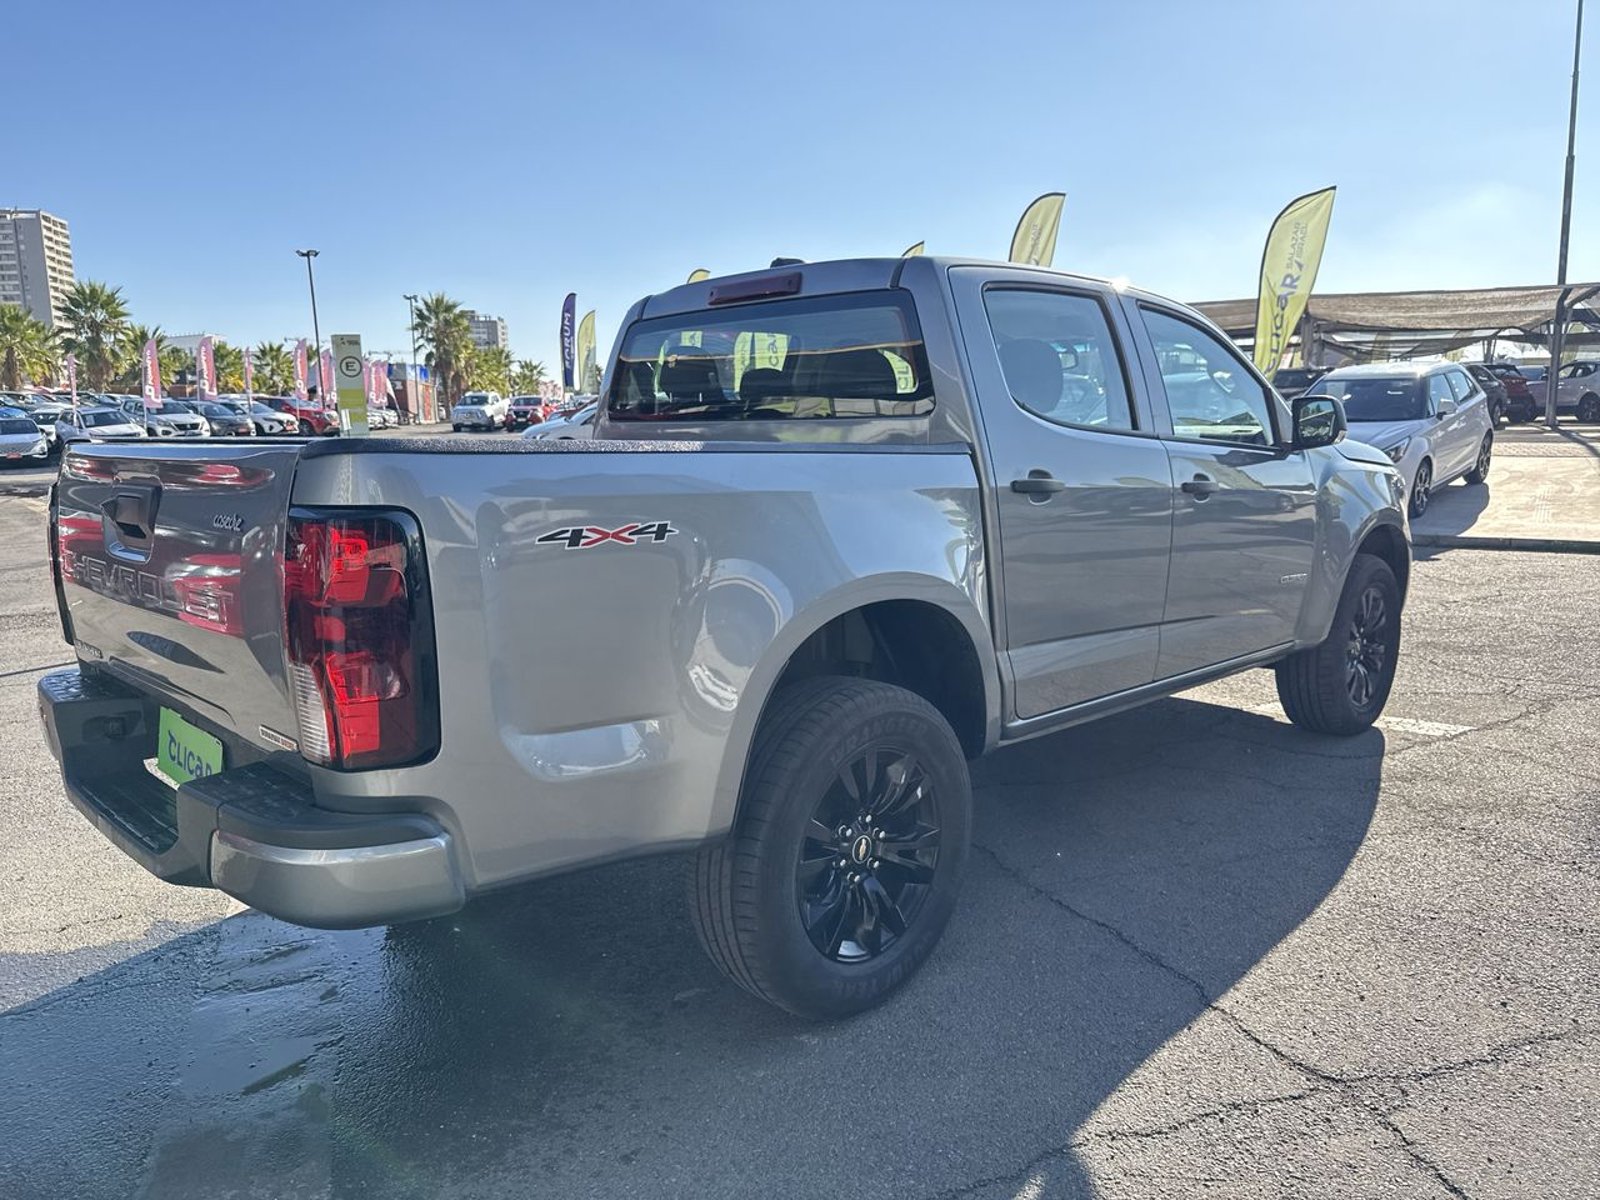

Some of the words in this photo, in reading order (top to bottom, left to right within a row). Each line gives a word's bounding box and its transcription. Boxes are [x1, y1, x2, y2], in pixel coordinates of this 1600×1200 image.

[1286, 222, 1301, 269] SALAZAR
[345, 361, 357, 371] E
[60, 538, 234, 632] CHEVROLET
